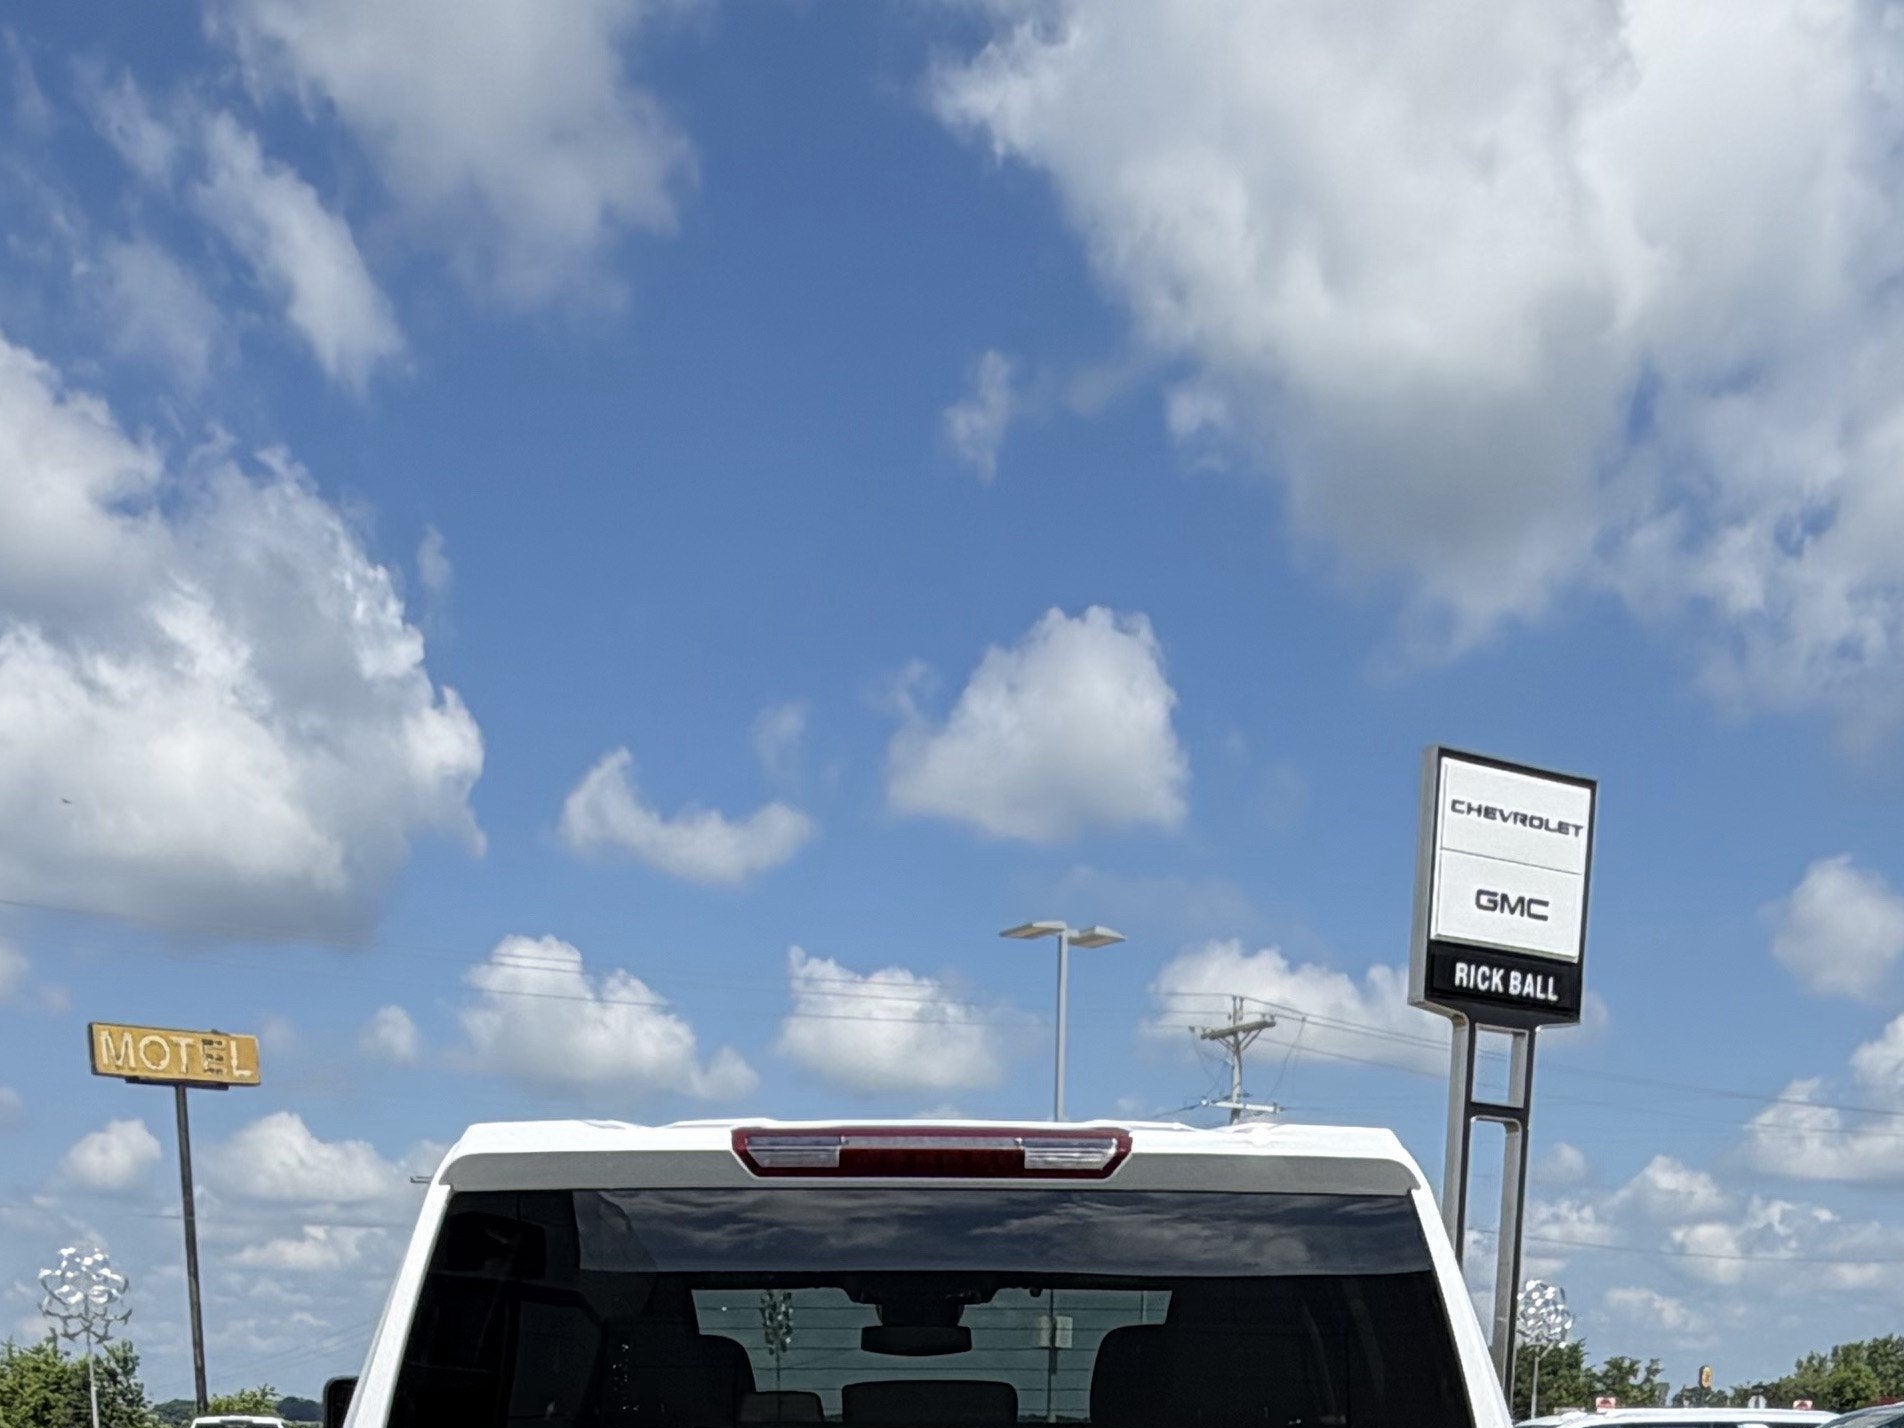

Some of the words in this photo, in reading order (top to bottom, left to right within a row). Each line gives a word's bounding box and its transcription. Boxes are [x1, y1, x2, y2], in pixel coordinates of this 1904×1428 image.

[1450, 799, 1583, 838] CHEVROLET
[1475, 888, 1549, 922] GMC
[1454, 961, 1504, 993] RICK
[1508, 967, 1559, 1001] BALL
[99, 1030, 251, 1077] MOTEL
